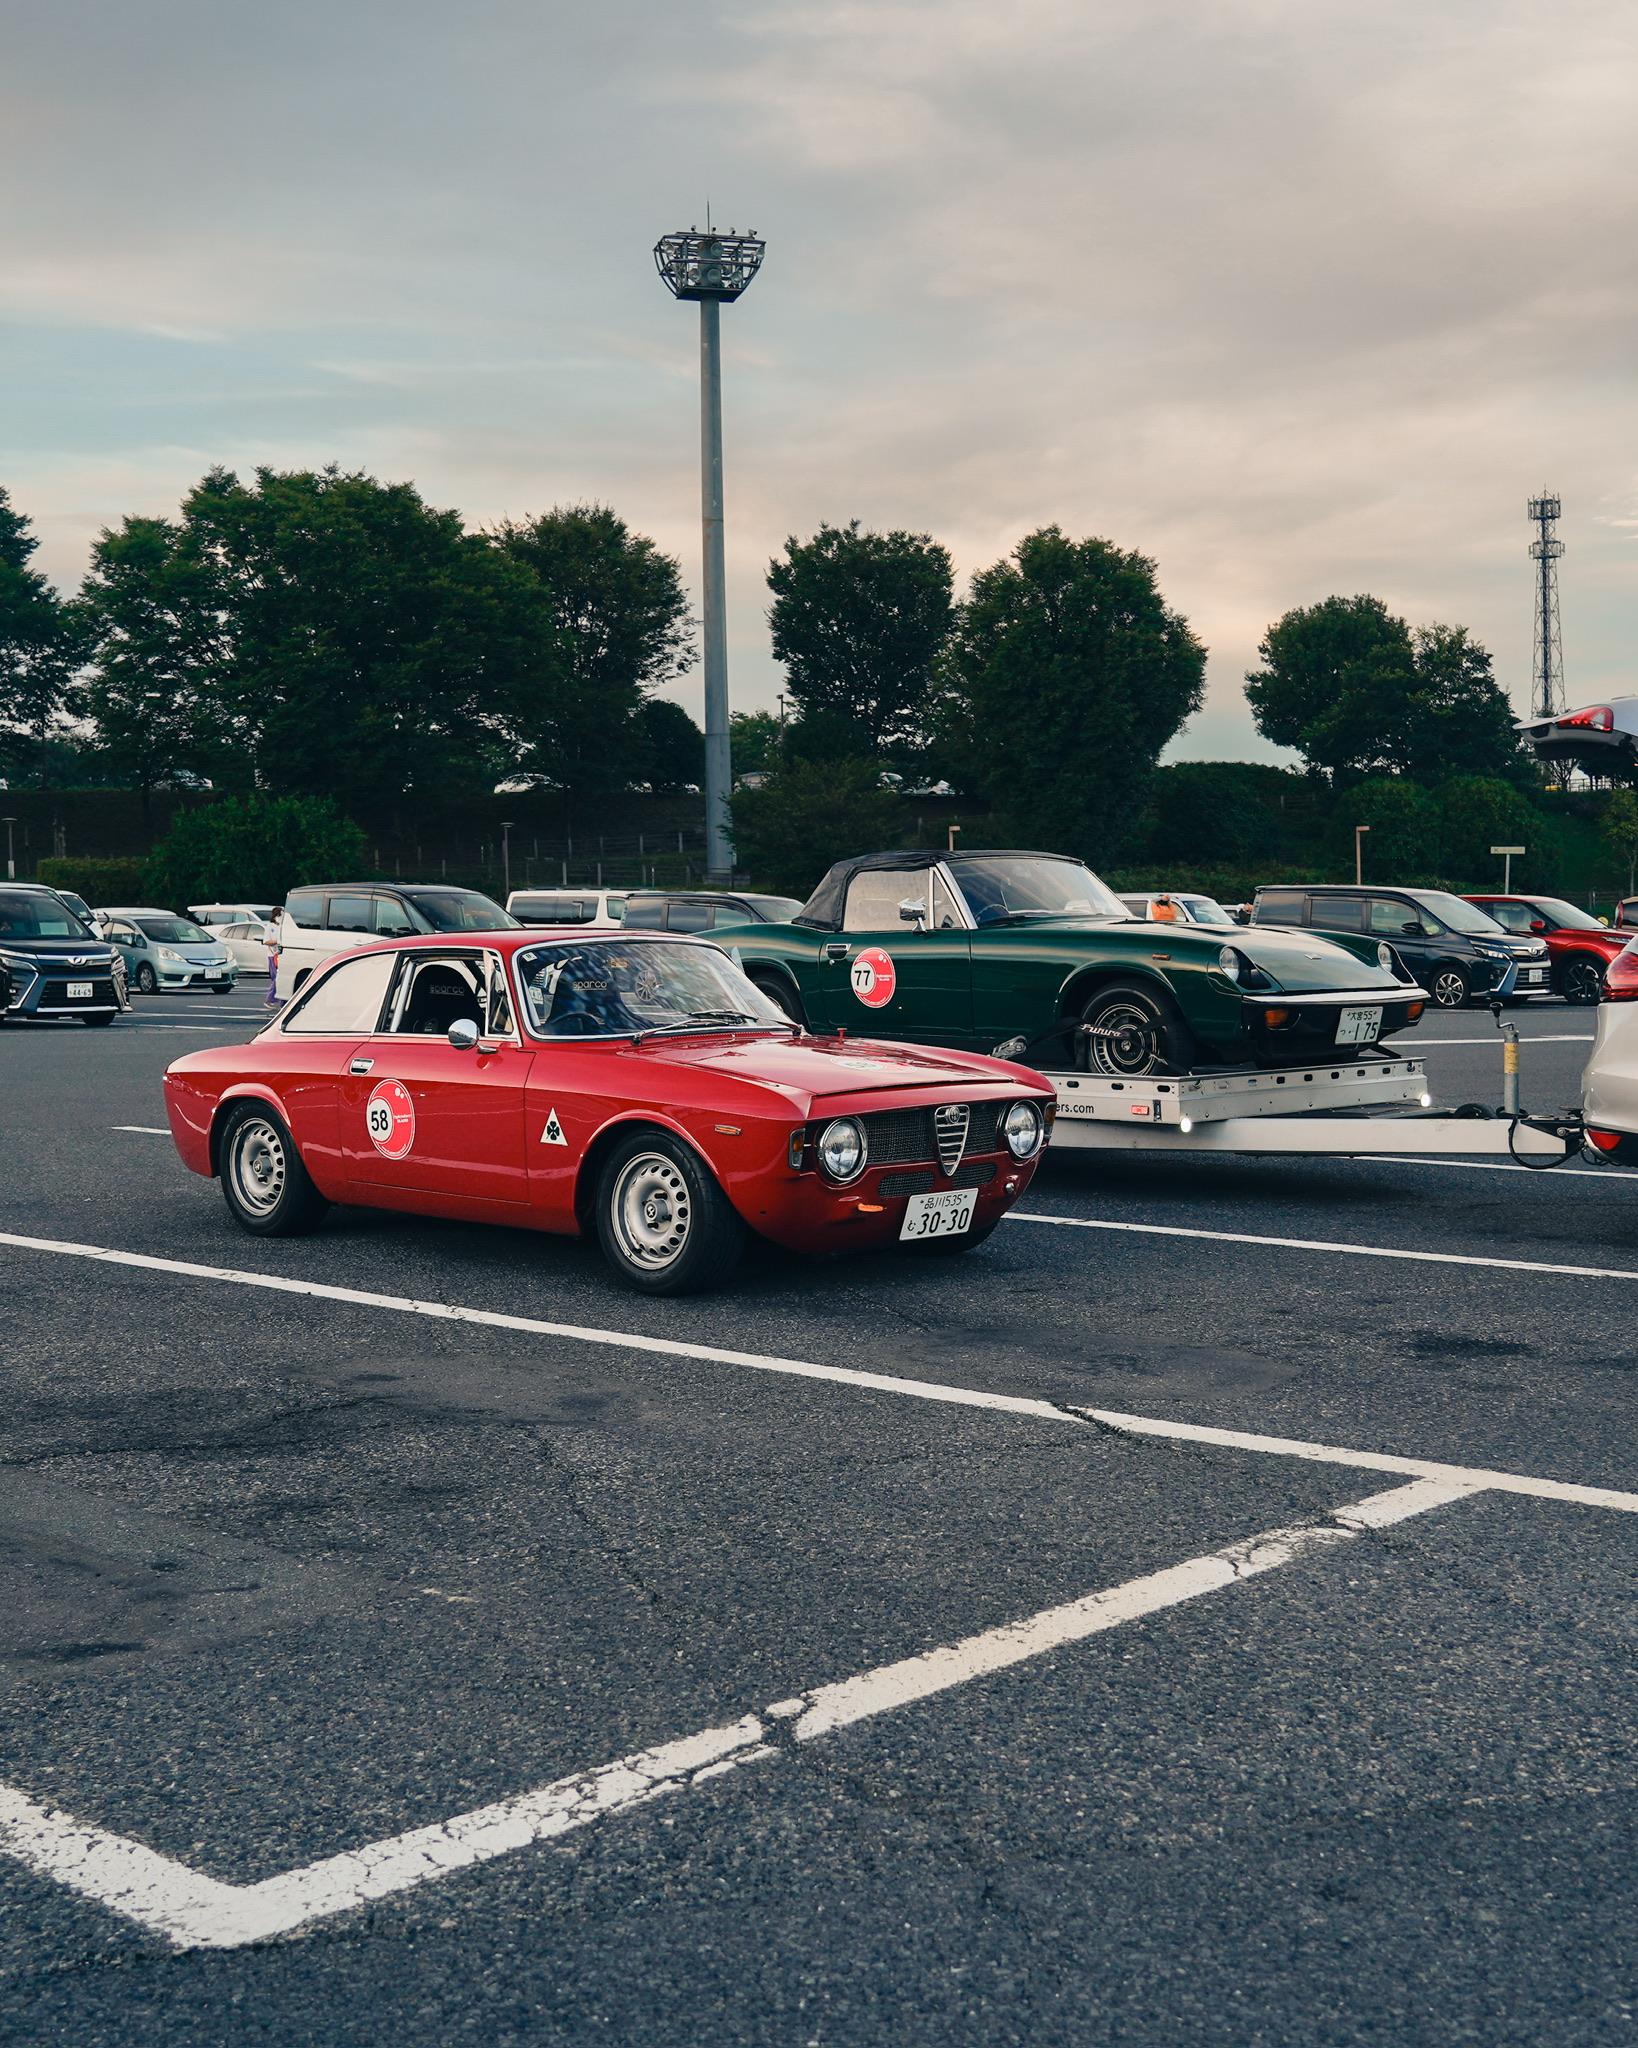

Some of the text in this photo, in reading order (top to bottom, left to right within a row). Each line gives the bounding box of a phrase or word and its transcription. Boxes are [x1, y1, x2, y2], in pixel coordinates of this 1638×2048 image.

[573, 980, 608, 991] sparco
[854, 970, 871, 986] 77
[371, 1109, 389, 1132] 58
[916, 1207, 970, 1235] 30-30
